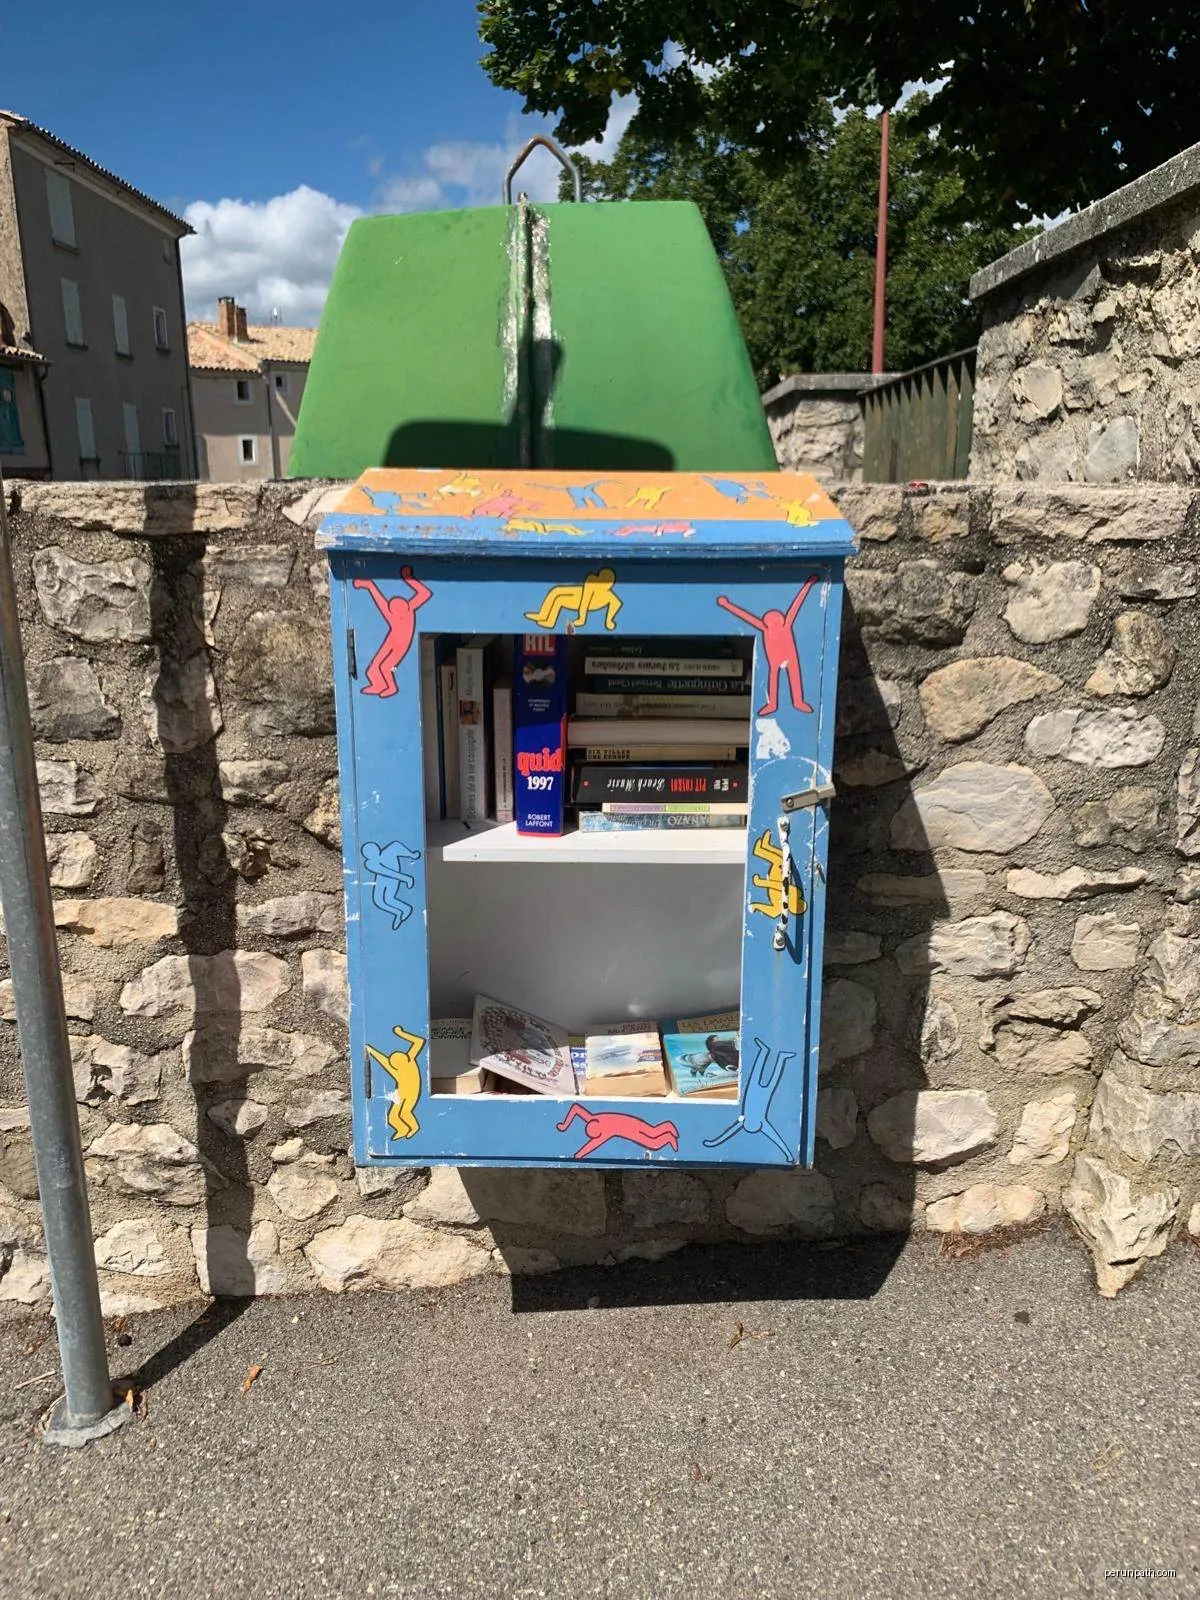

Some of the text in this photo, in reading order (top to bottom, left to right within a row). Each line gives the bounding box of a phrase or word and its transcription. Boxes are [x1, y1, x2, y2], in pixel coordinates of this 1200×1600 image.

[525, 635, 554, 652] RTL
[517, 747, 564, 777] quid
[526, 775, 554, 791] 1997
[606, 777, 666, 793] Beach Music
[525, 819, 554, 828] LAFFONT
